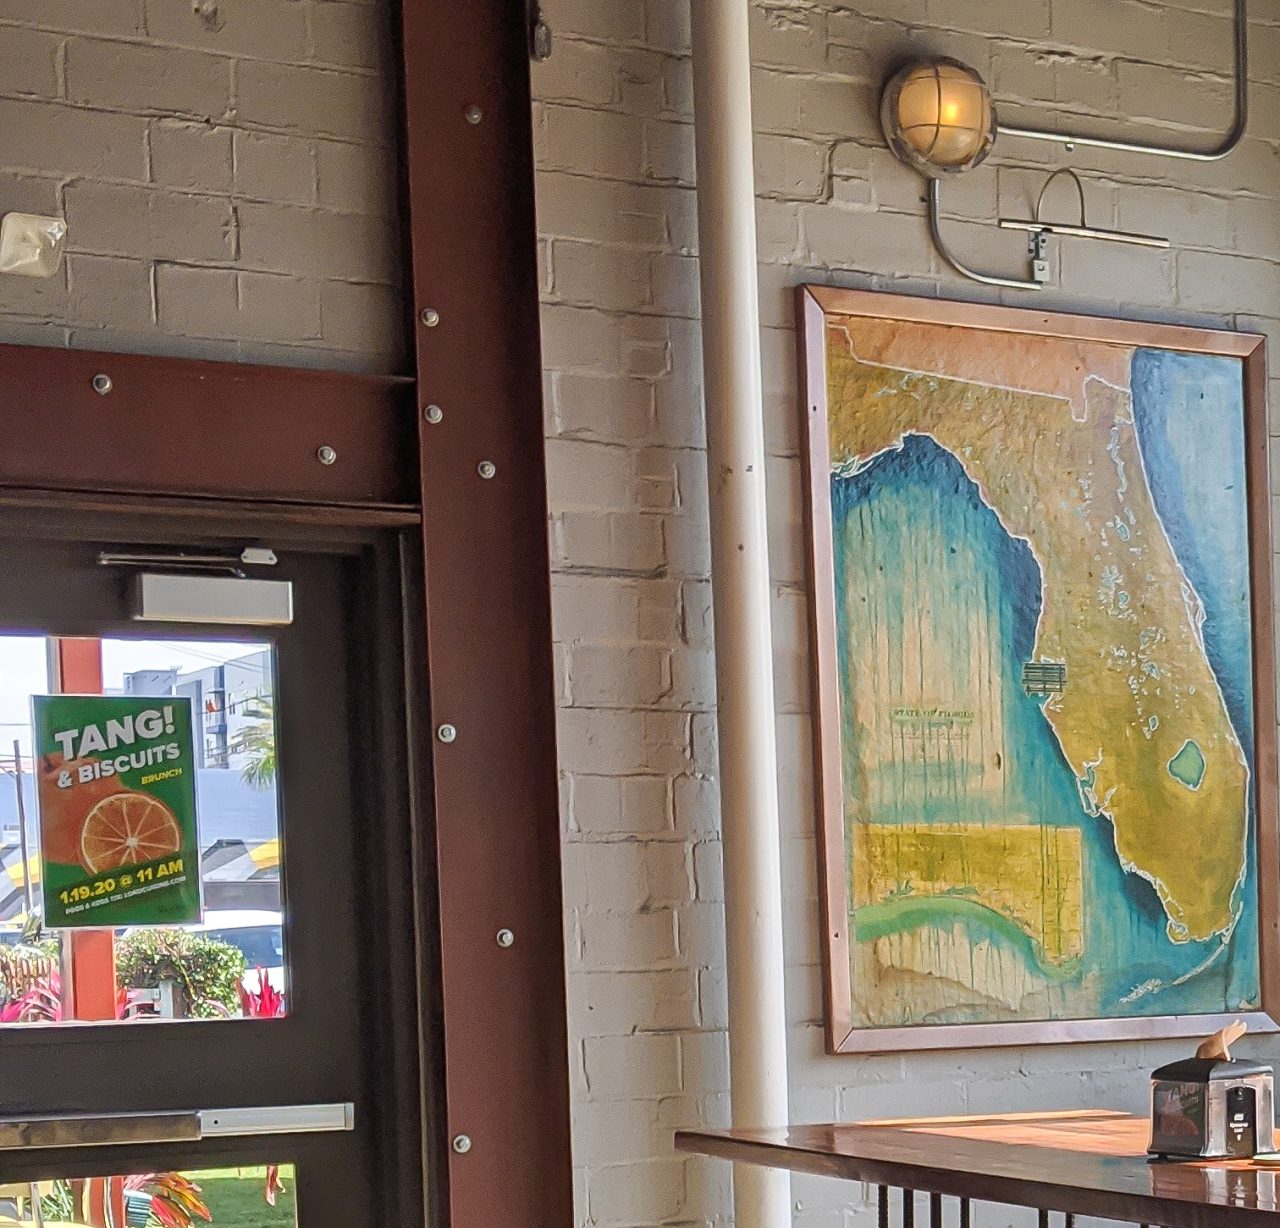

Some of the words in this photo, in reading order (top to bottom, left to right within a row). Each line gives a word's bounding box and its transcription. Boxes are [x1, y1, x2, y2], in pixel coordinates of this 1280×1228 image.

[54, 705, 176, 761] TANG!
[57, 770, 73, 789] &
[78, 742, 181, 784] BISCUITS
[141, 767, 183, 785] BRUNCH
[60, 878, 116, 904] 1.19.20
[120, 874, 133, 887] @
[136, 867, 153, 882] 11
[156, 859, 184, 878] AM
